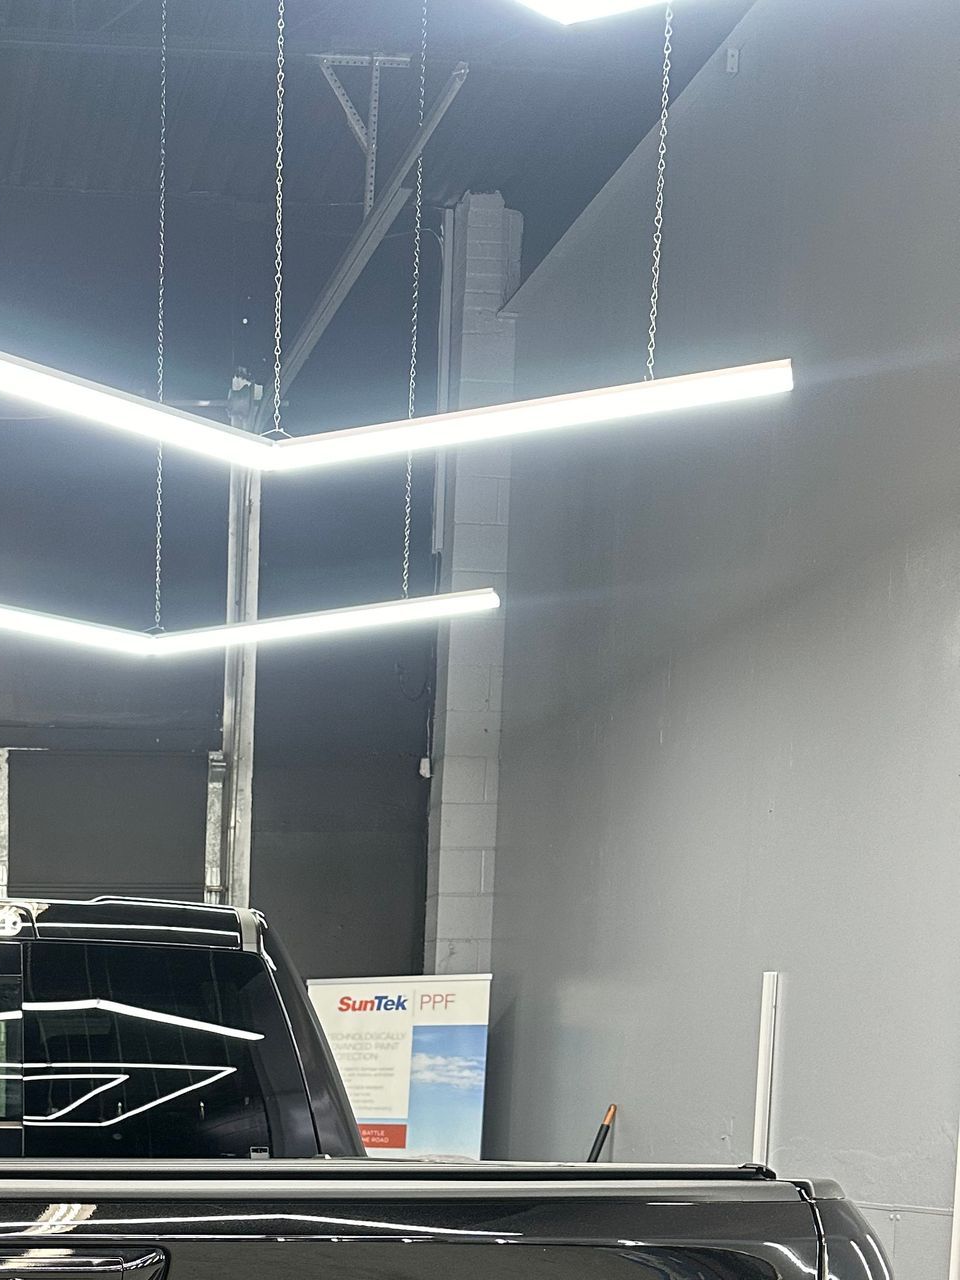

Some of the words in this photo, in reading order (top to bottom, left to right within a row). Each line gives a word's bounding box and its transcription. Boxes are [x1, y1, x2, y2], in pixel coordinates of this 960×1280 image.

[338, 995, 408, 1012] SunTek
[420, 993, 456, 1010] PPF
[336, 1052, 378, 1061] OTECTION
[371, 1136, 390, 1144] ROAD
